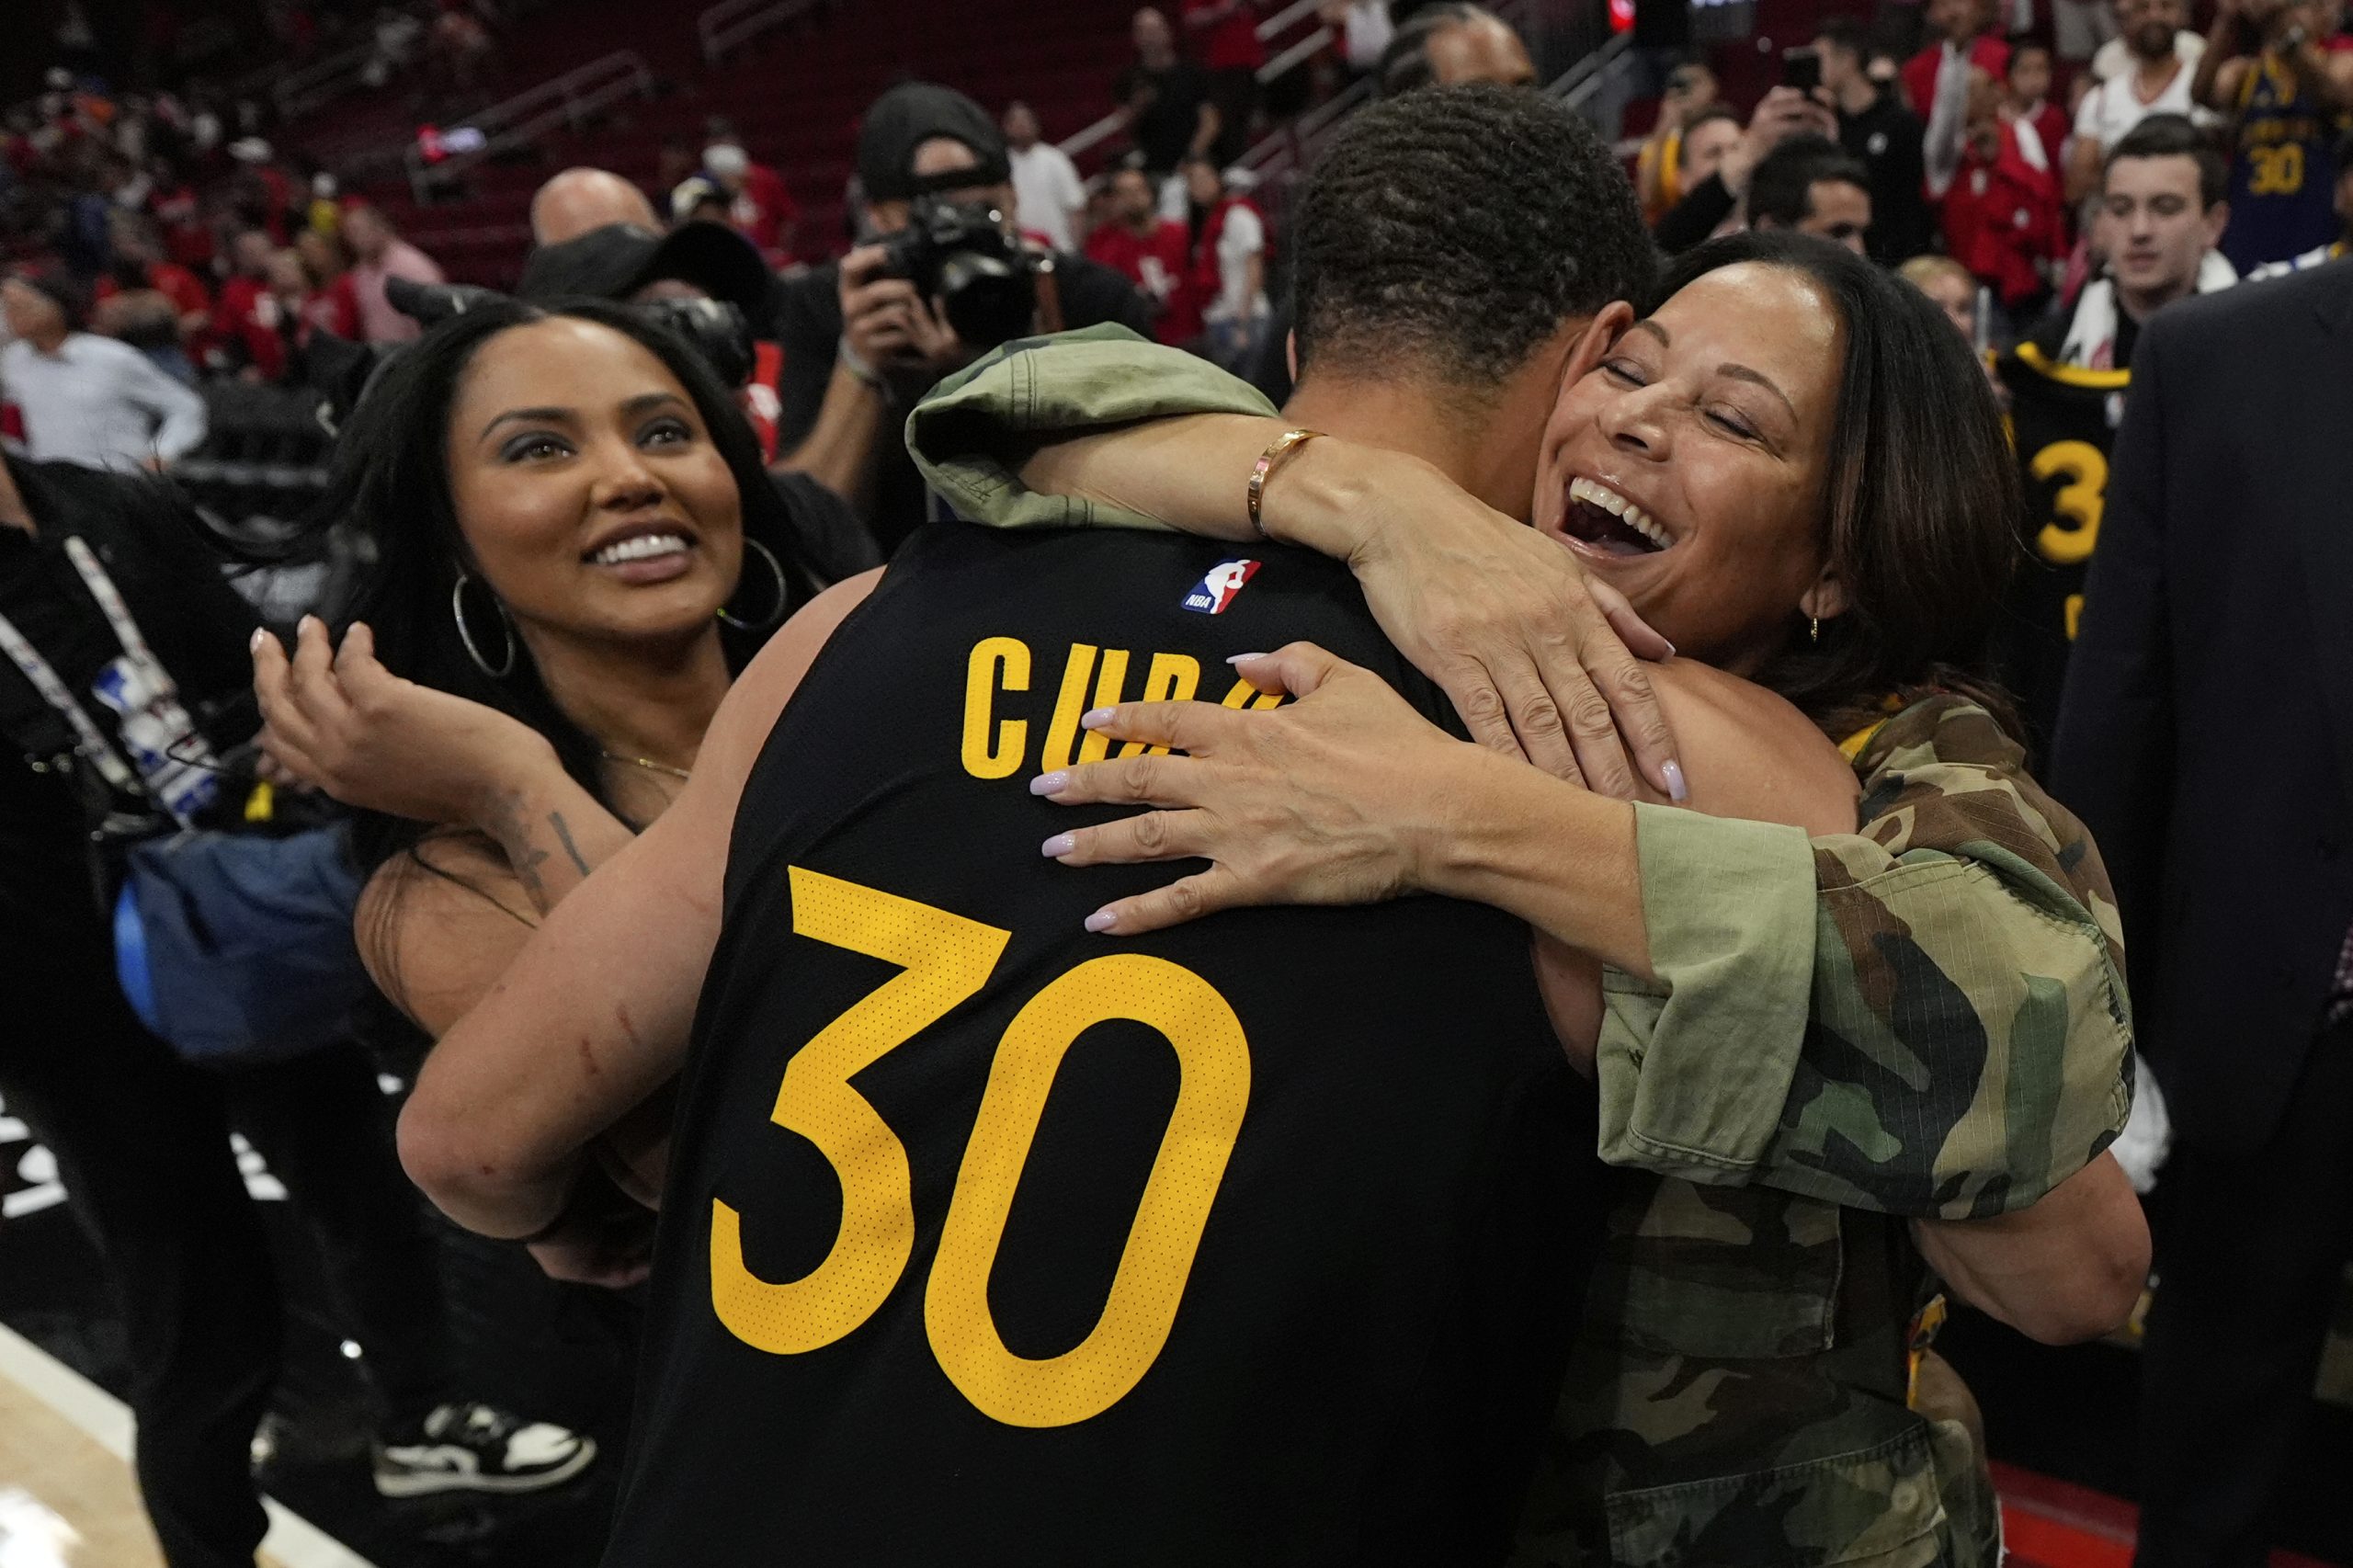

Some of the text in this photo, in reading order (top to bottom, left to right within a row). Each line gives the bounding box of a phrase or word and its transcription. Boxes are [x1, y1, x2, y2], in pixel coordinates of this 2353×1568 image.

[2248, 143, 2302, 195] 30
[1185, 594, 1212, 608] NBA
[961, 636, 1284, 779] CUR
[710, 865, 1252, 1428] 30
